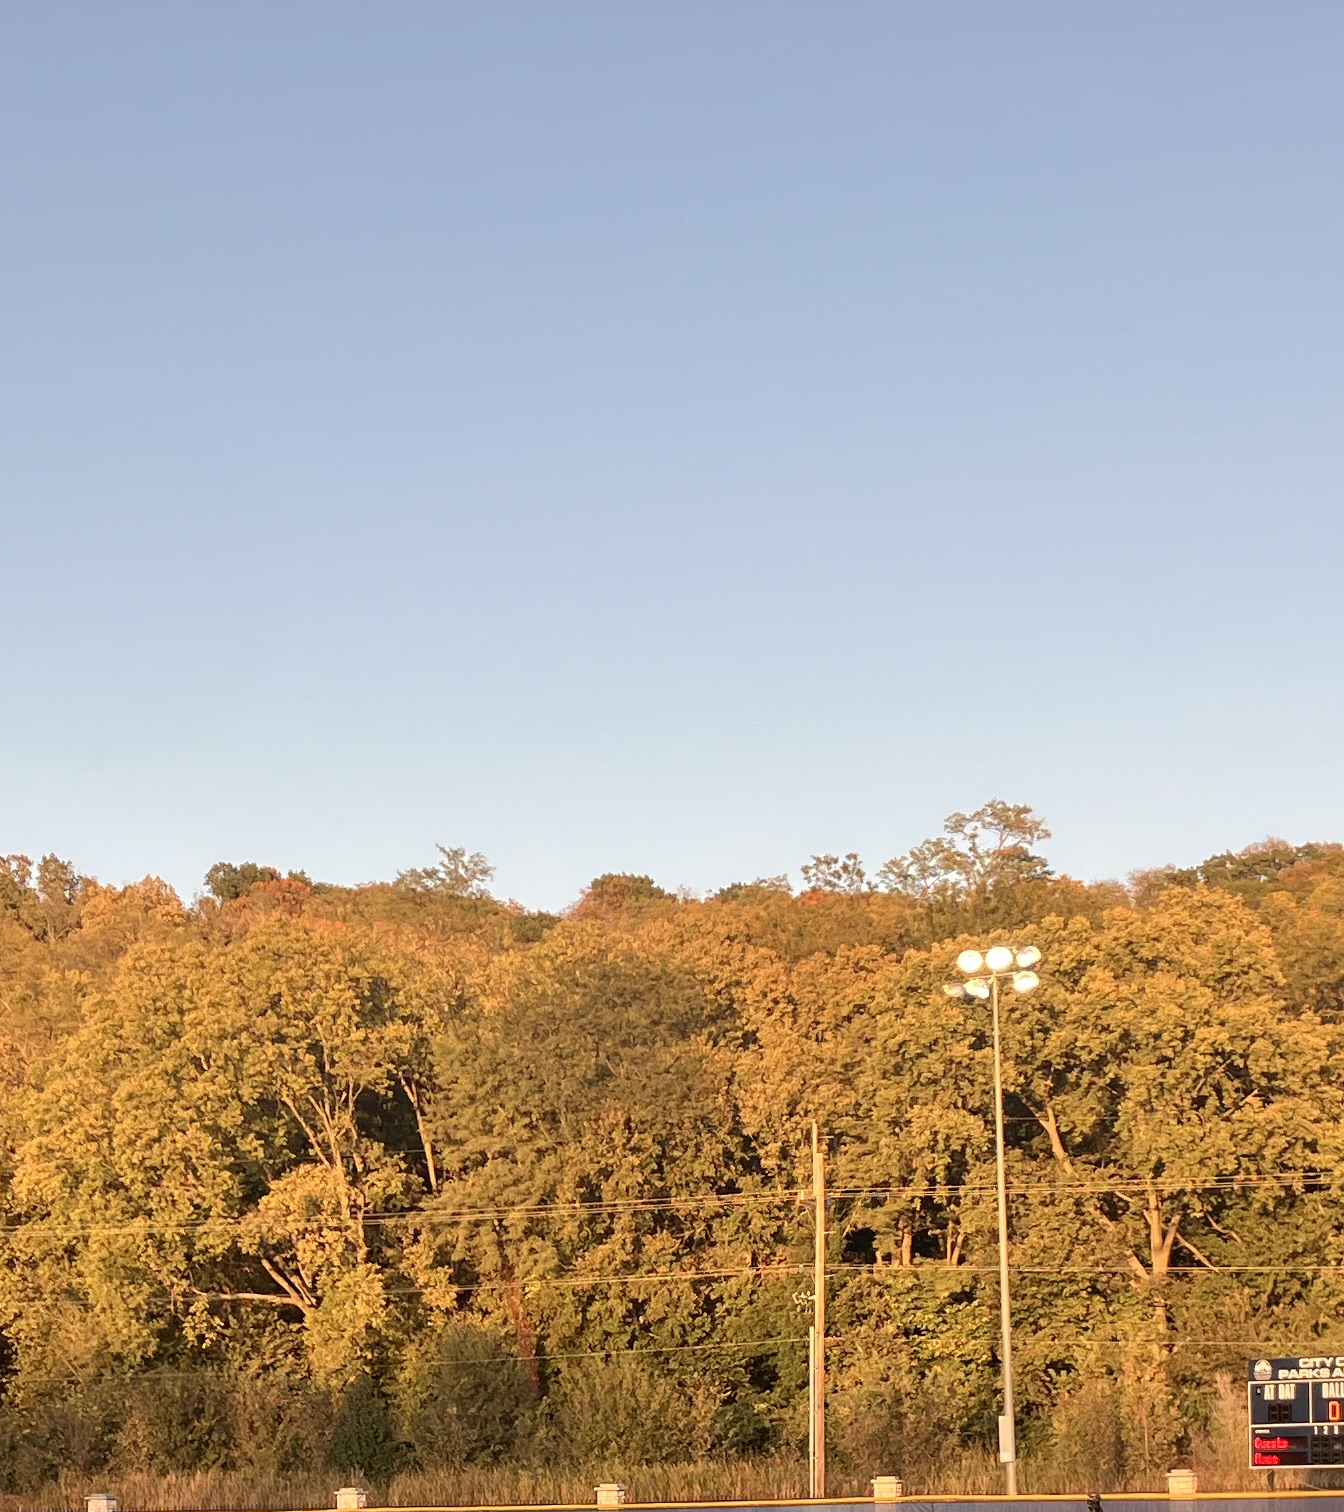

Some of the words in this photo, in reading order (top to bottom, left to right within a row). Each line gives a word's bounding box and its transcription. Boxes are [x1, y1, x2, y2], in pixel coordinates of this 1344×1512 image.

[1298, 1357, 1334, 1368] CITY
[1278, 1368, 1331, 1380] PARKS
[1263, 1384, 1275, 1400] AT
[1278, 1383, 1295, 1400] BAT
[1328, 1400, 1341, 1421] 0
